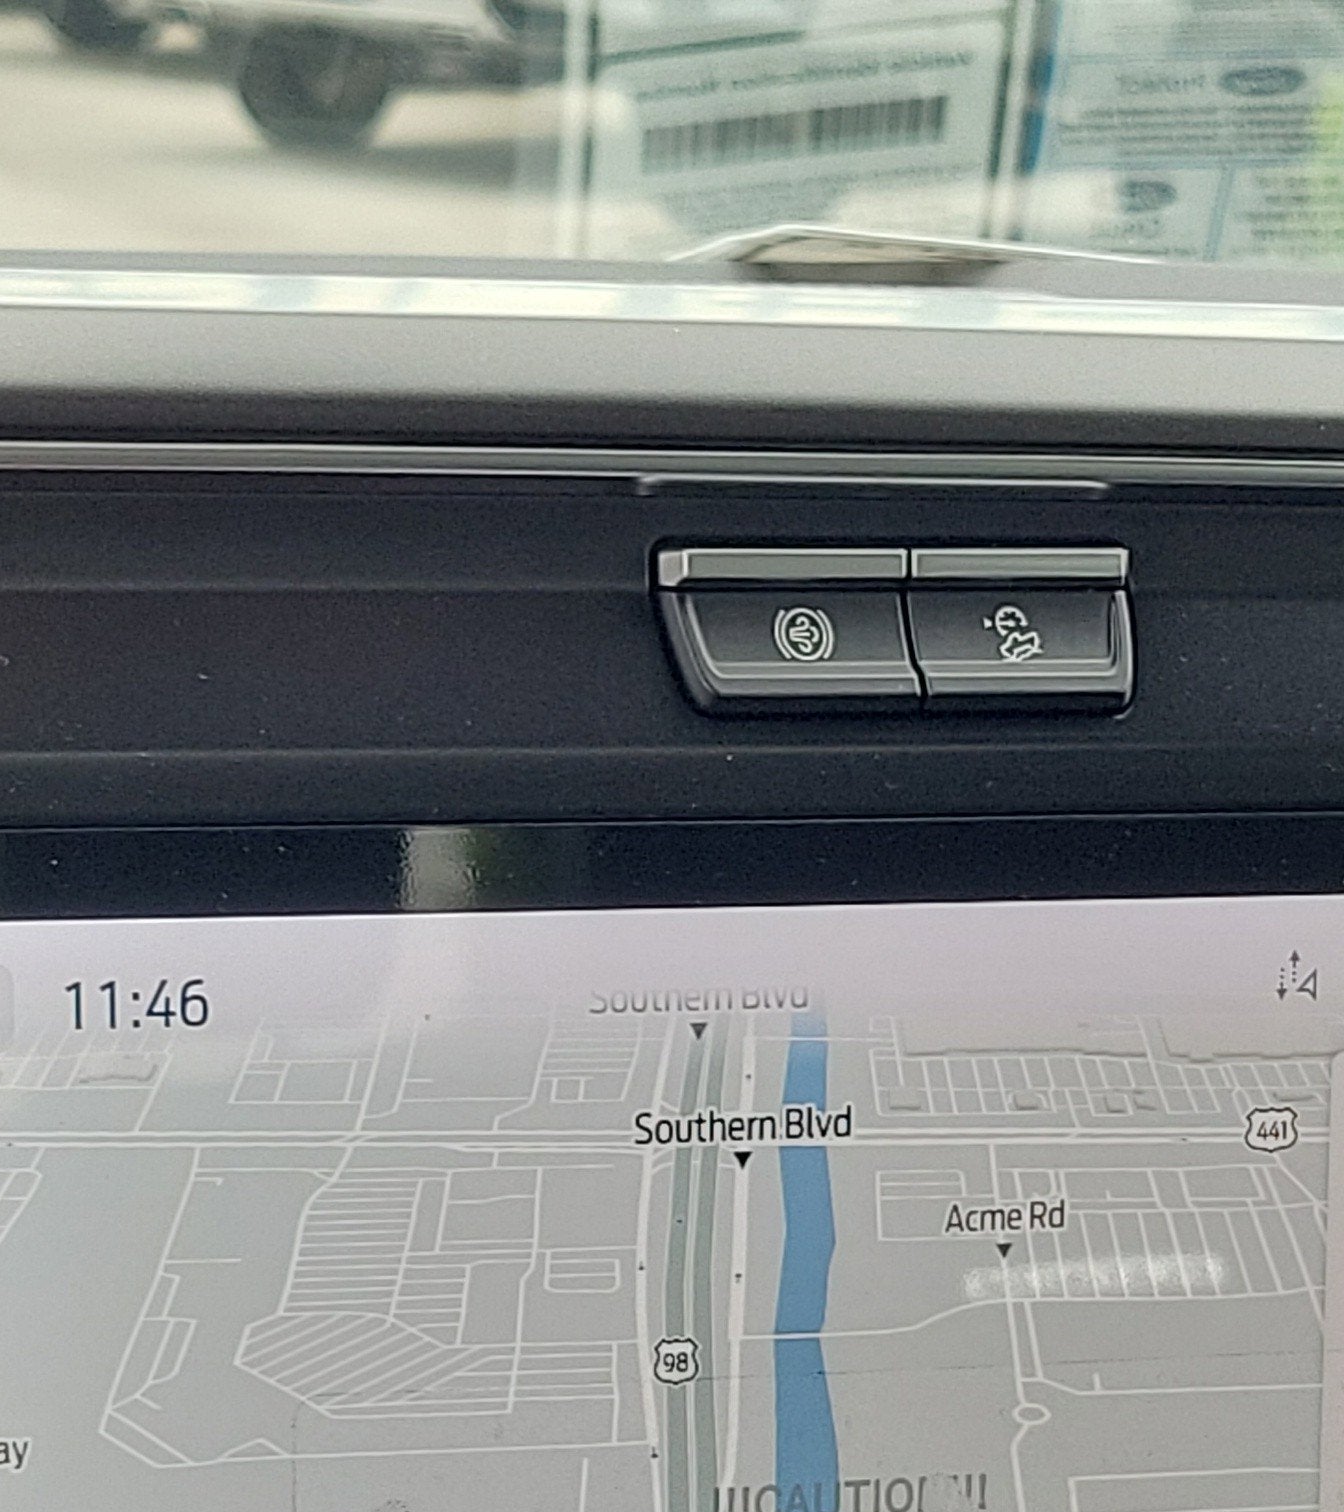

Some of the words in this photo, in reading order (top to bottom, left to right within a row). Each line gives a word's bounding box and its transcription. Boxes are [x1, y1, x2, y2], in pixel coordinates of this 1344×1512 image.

[65, 979, 209, 1029] 11:46
[635, 1110, 776, 1144] Southern
[786, 1105, 851, 1138] Blvd
[1257, 1121, 1287, 1140] 441
[945, 1205, 1022, 1233] Acme
[1030, 1200, 1065, 1229] Rd
[663, 1352, 688, 1372] 98
